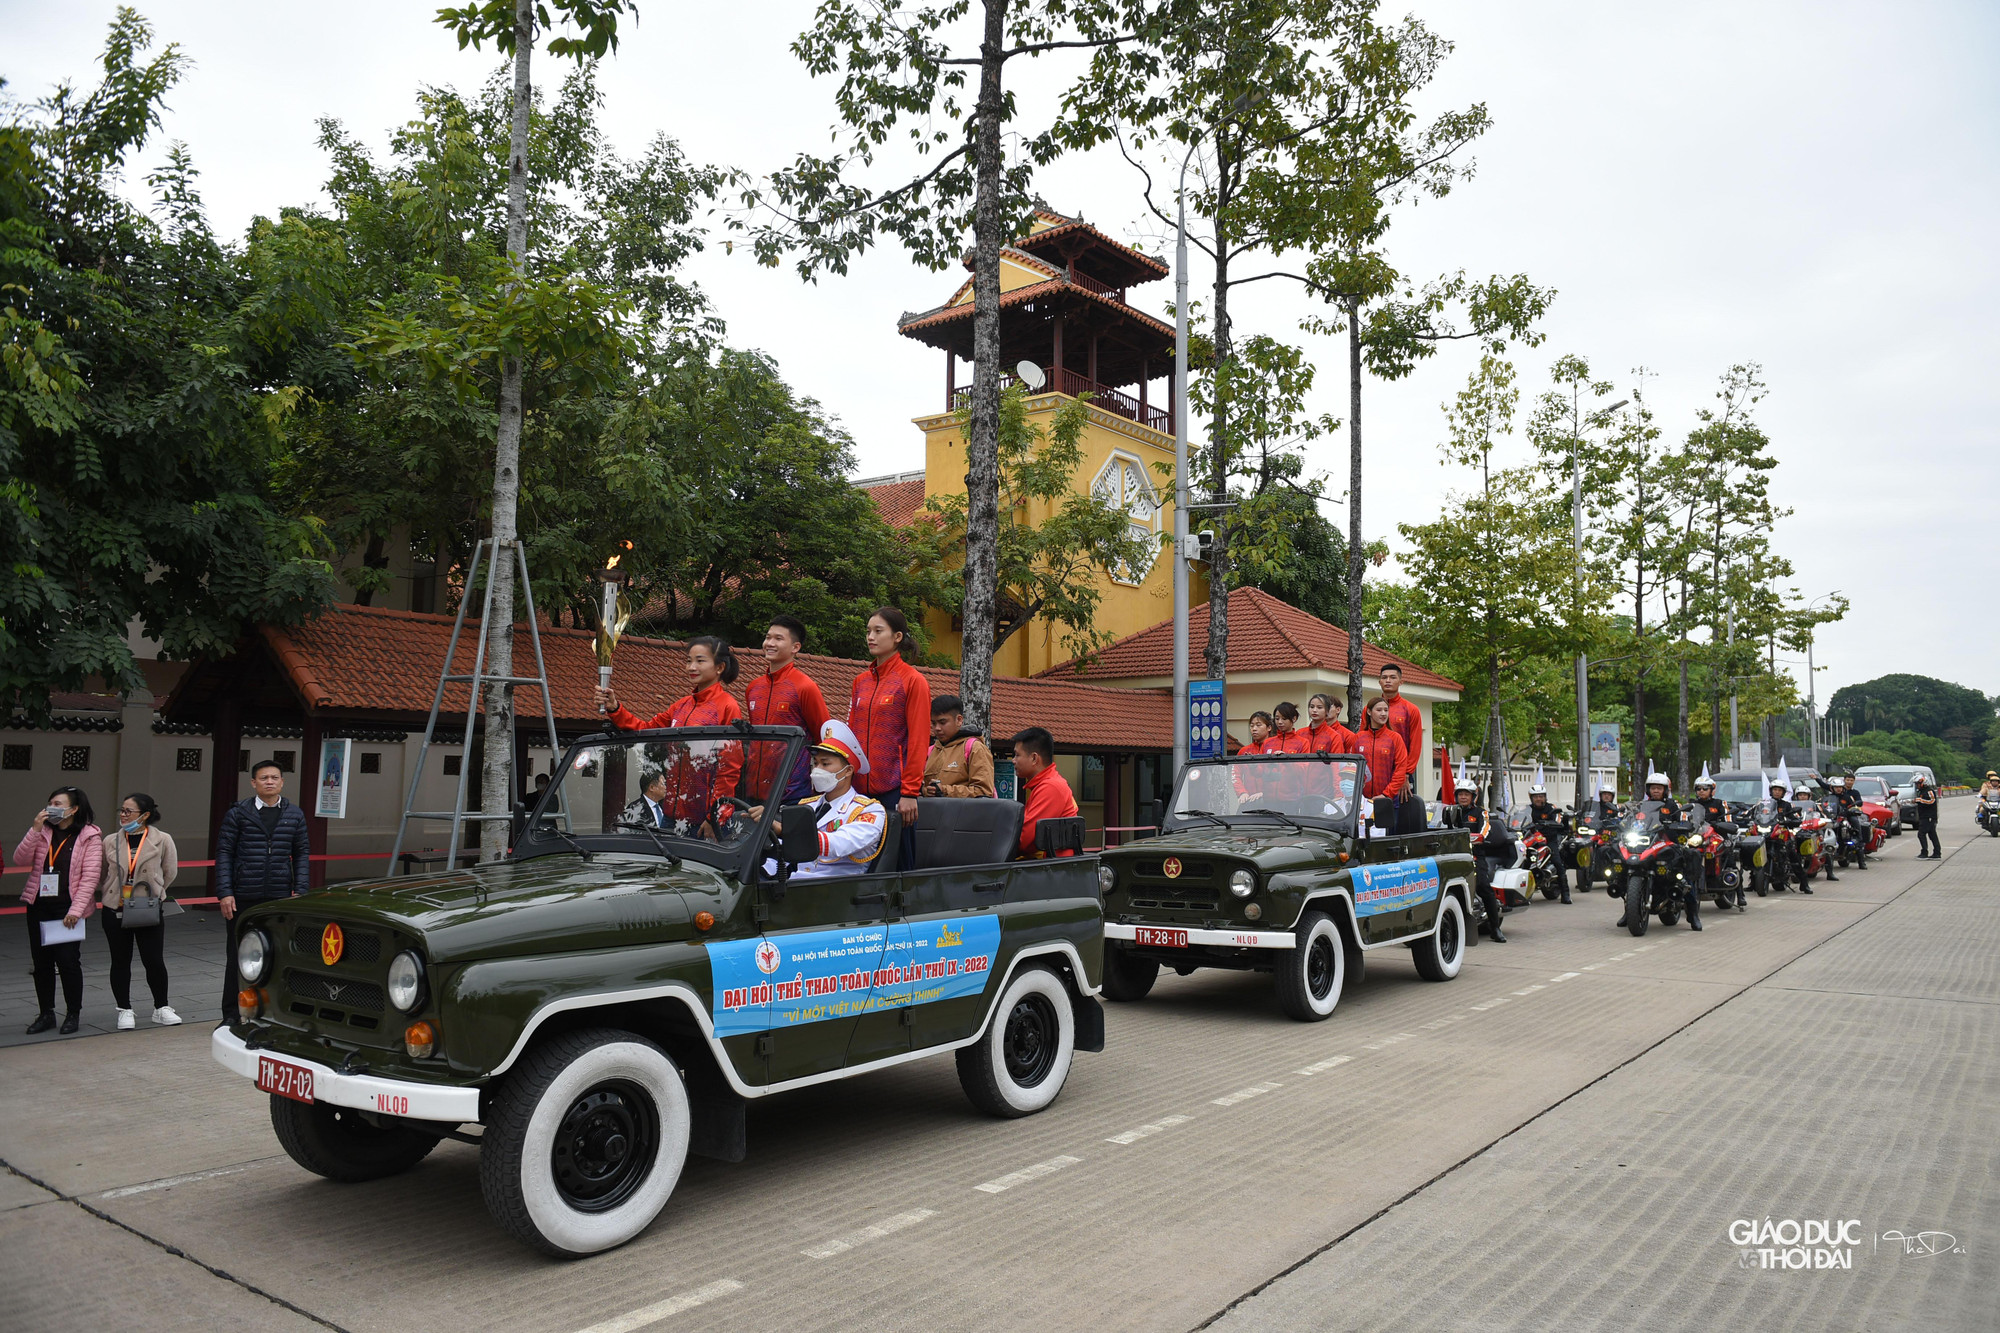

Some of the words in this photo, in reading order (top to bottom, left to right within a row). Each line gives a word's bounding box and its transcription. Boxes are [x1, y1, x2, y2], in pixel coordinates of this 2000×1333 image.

[843, 936, 855, 945] BAN
[856, 933, 864, 943] TỔ
[865, 933, 882, 942] CHỨC
[1137, 929, 1186, 946] TM-28-10
[1236, 935, 1258, 945] NLQĐ
[792, 954, 804, 963] ĐẠI
[805, 951, 817, 961] HỘI
[817, 948, 829, 959] THỂ
[830, 948, 846, 958] THAO
[847, 945, 864, 956] TOÀN
[865, 944, 882, 954] QUỐC
[906, 941, 912, 949] IX
[915, 939, 928, 948] 2022
[723, 988, 748, 1013] ĐẠI
[750, 981, 773, 1008] HỘI
[776, 972, 803, 1001] THỂ
[805, 976, 837, 997] THAO
[840, 968, 871, 991] TOÀN
[873, 962, 901, 988] QUỐC
[902, 959, 922, 983] LẦN
[924, 957, 946, 979] THỨ
[947, 959, 958, 976] IX
[964, 955, 988, 974] 2022
[803, 1005, 826, 1021] MỘT
[829, 1000, 849, 1017] VIỆT
[851, 998, 874, 1012] NAM
[877, 992, 912, 1008] CƯỜNG
[260, 1060, 312, 1099] TM-27-02
[377, 1093, 408, 1115] NLQĐ
